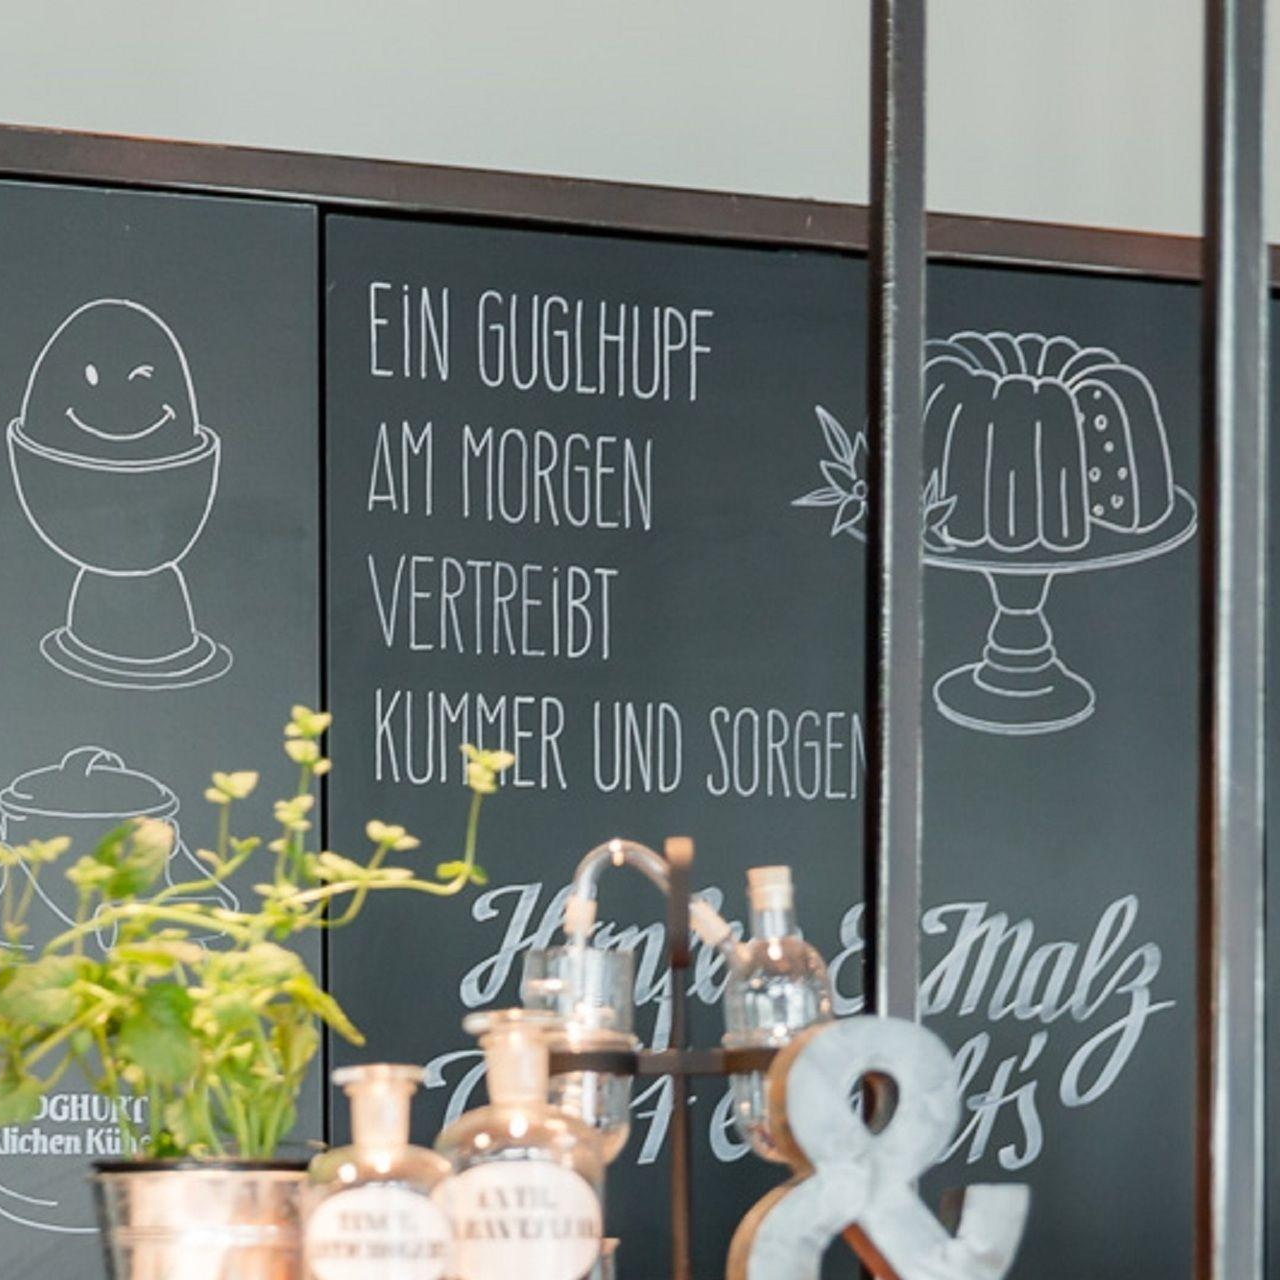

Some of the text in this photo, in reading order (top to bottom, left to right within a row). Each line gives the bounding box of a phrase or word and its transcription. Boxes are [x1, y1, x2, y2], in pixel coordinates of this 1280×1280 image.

[478, 290, 714, 402] GUGLHUPF
[368, 421, 653, 532] AM MORGEN
[375, 688, 568, 791] KUMMER
[593, 701, 684, 794] UND
[919, 894, 1177, 1107] Malz
